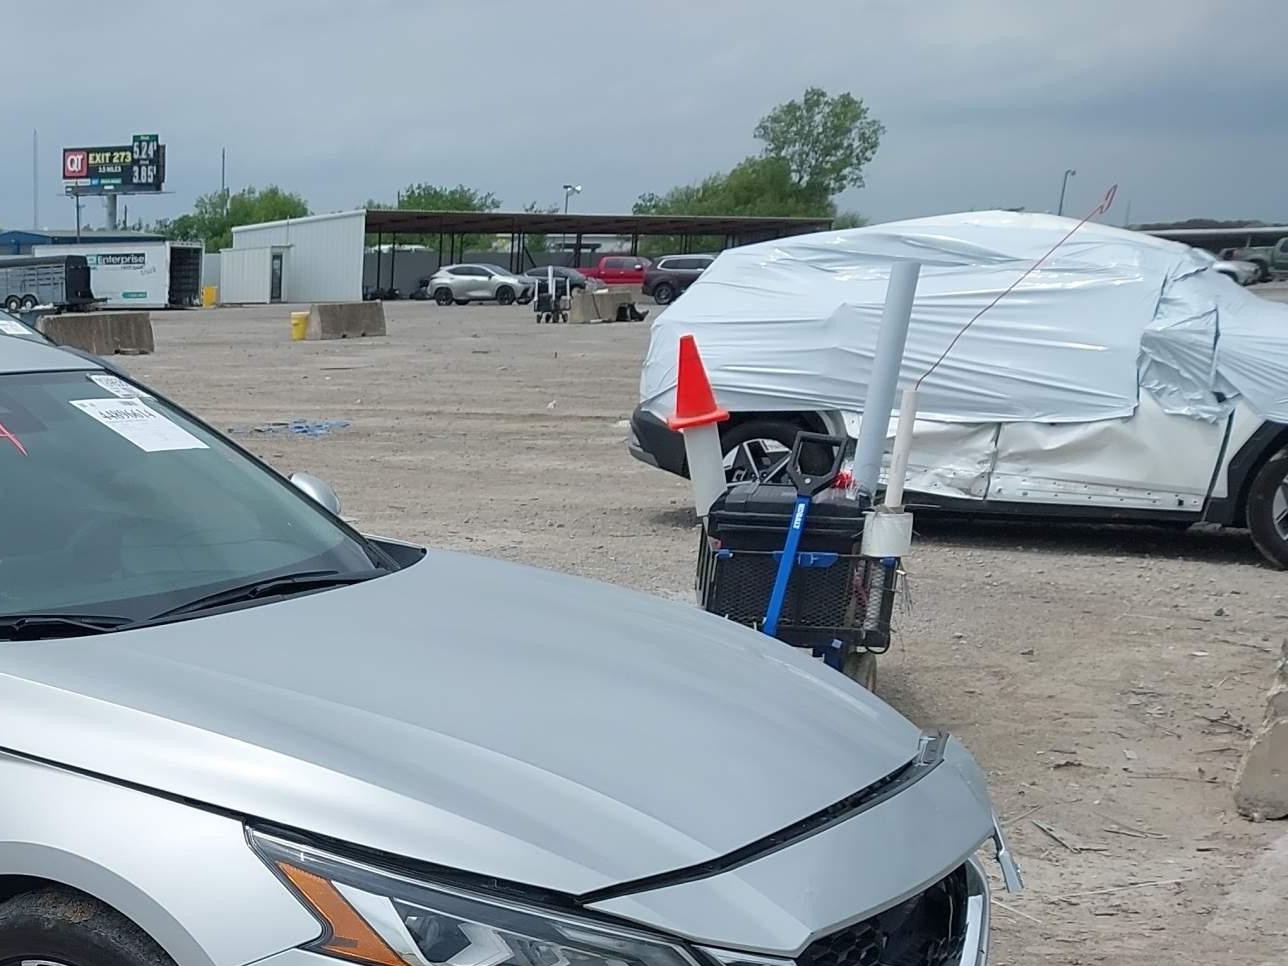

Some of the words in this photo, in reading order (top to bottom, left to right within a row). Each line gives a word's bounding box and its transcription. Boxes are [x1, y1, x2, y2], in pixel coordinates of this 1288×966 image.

[67, 155, 84, 172] QT
[88, 152, 112, 164] EXIT
[112, 151, 132, 163] 273
[97, 255, 145, 265] Enterprise
